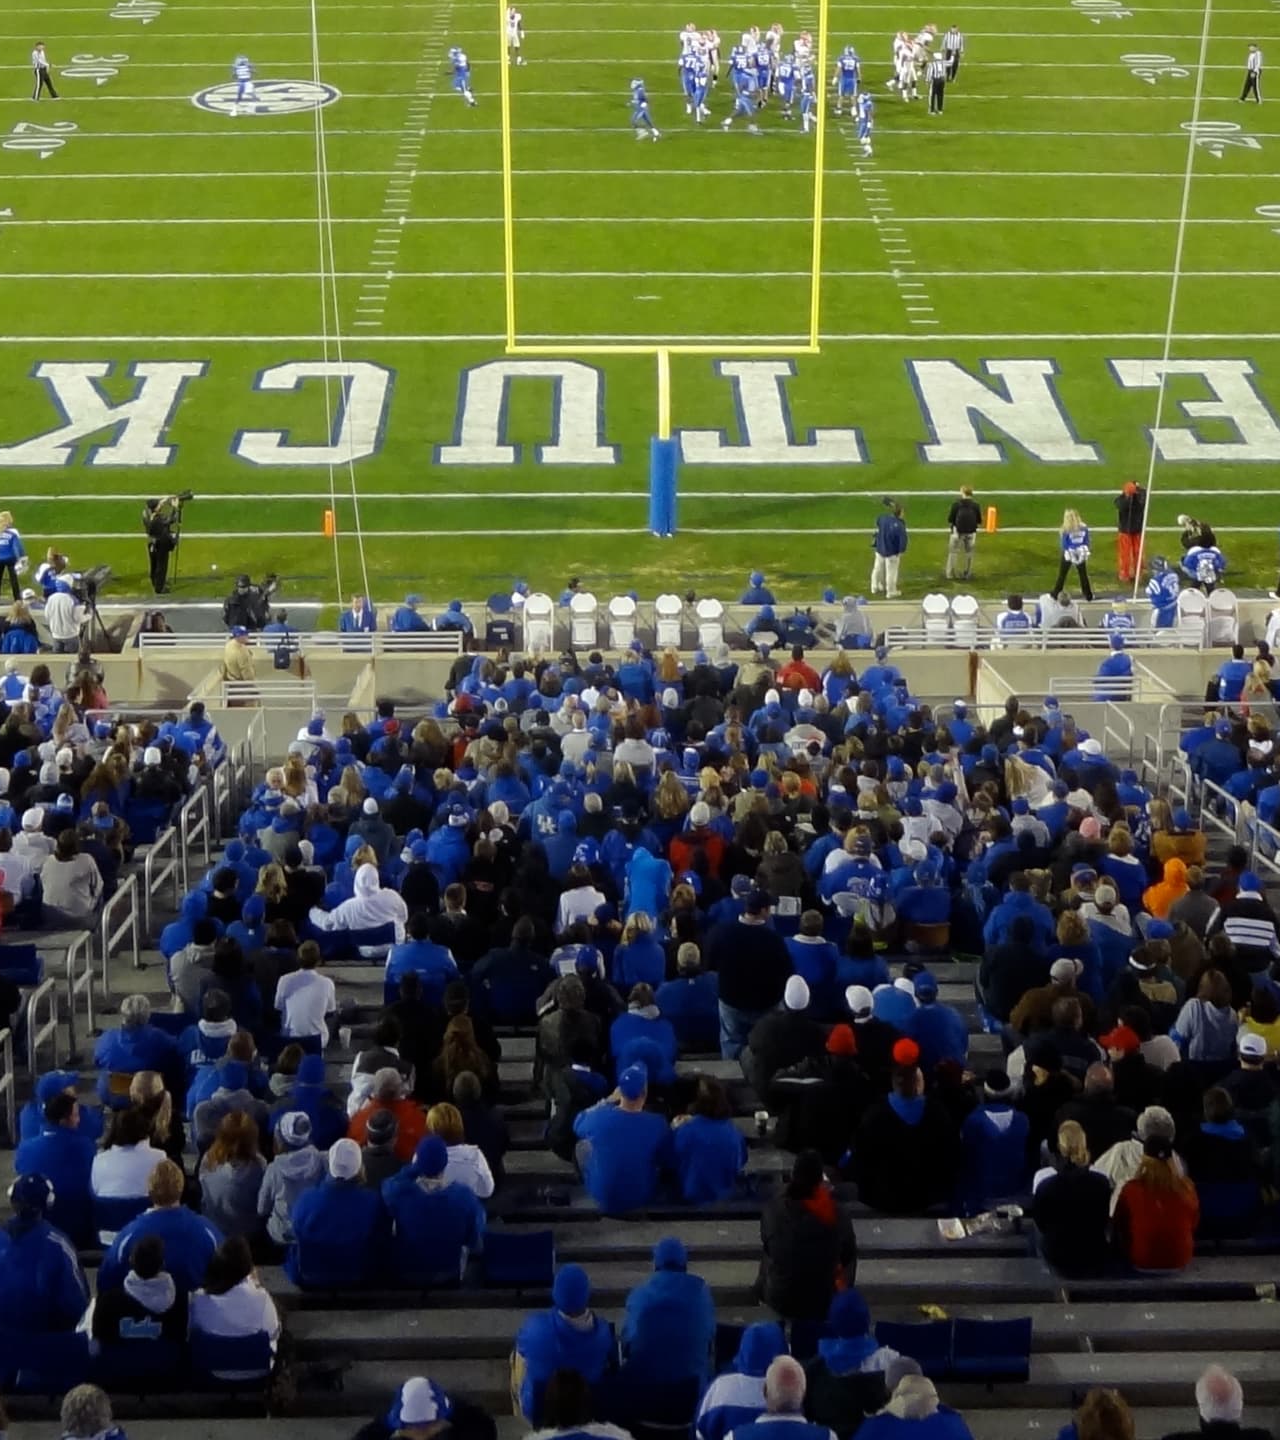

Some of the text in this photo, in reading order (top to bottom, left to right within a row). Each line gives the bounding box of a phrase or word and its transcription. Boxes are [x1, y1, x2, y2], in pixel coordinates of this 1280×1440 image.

[2, 121, 78, 149] 20
[1179, 121, 1263, 150] 20
[537, 814, 556, 835] UK
